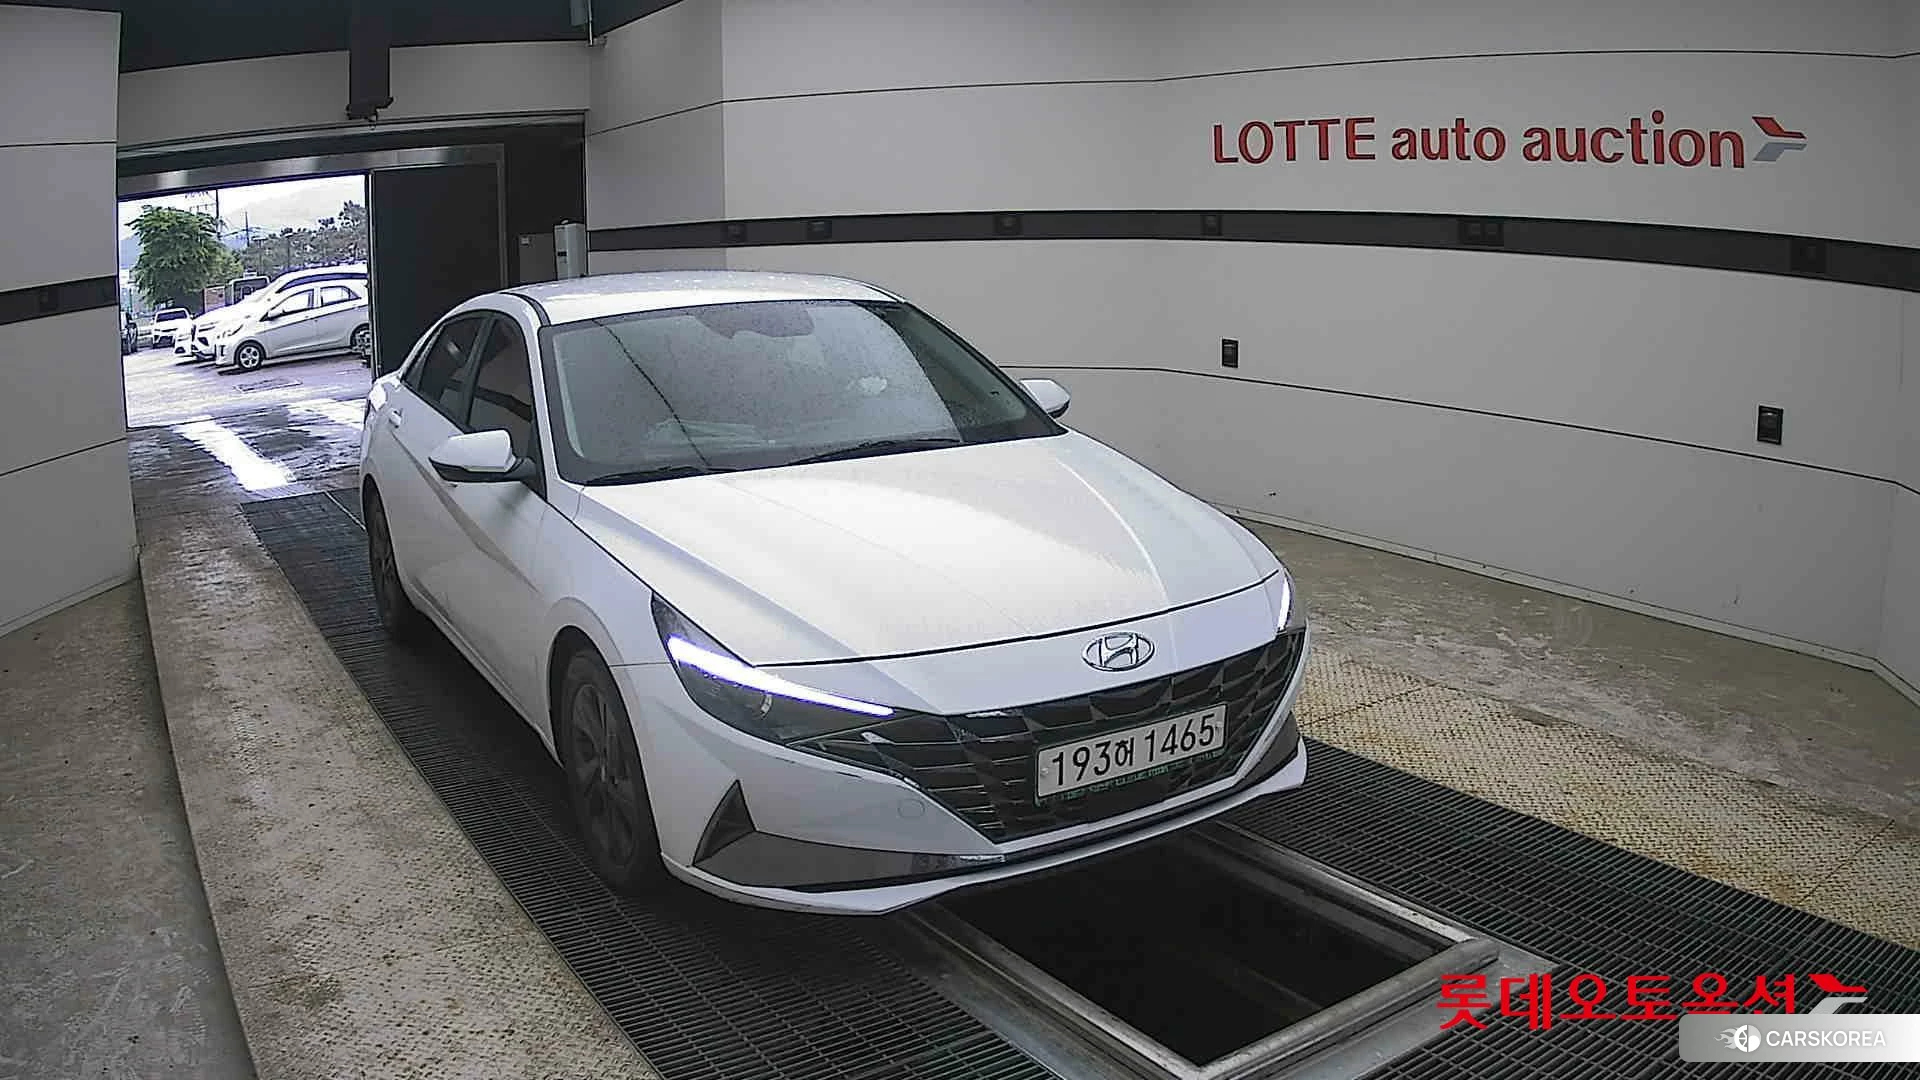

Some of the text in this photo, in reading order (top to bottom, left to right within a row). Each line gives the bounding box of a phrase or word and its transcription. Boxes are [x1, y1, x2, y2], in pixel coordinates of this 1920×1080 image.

[1212, 110, 1745, 168] LOTTE auto auction
[1052, 737, 1134, 786] 193허
[1145, 714, 1215, 762] 1465
